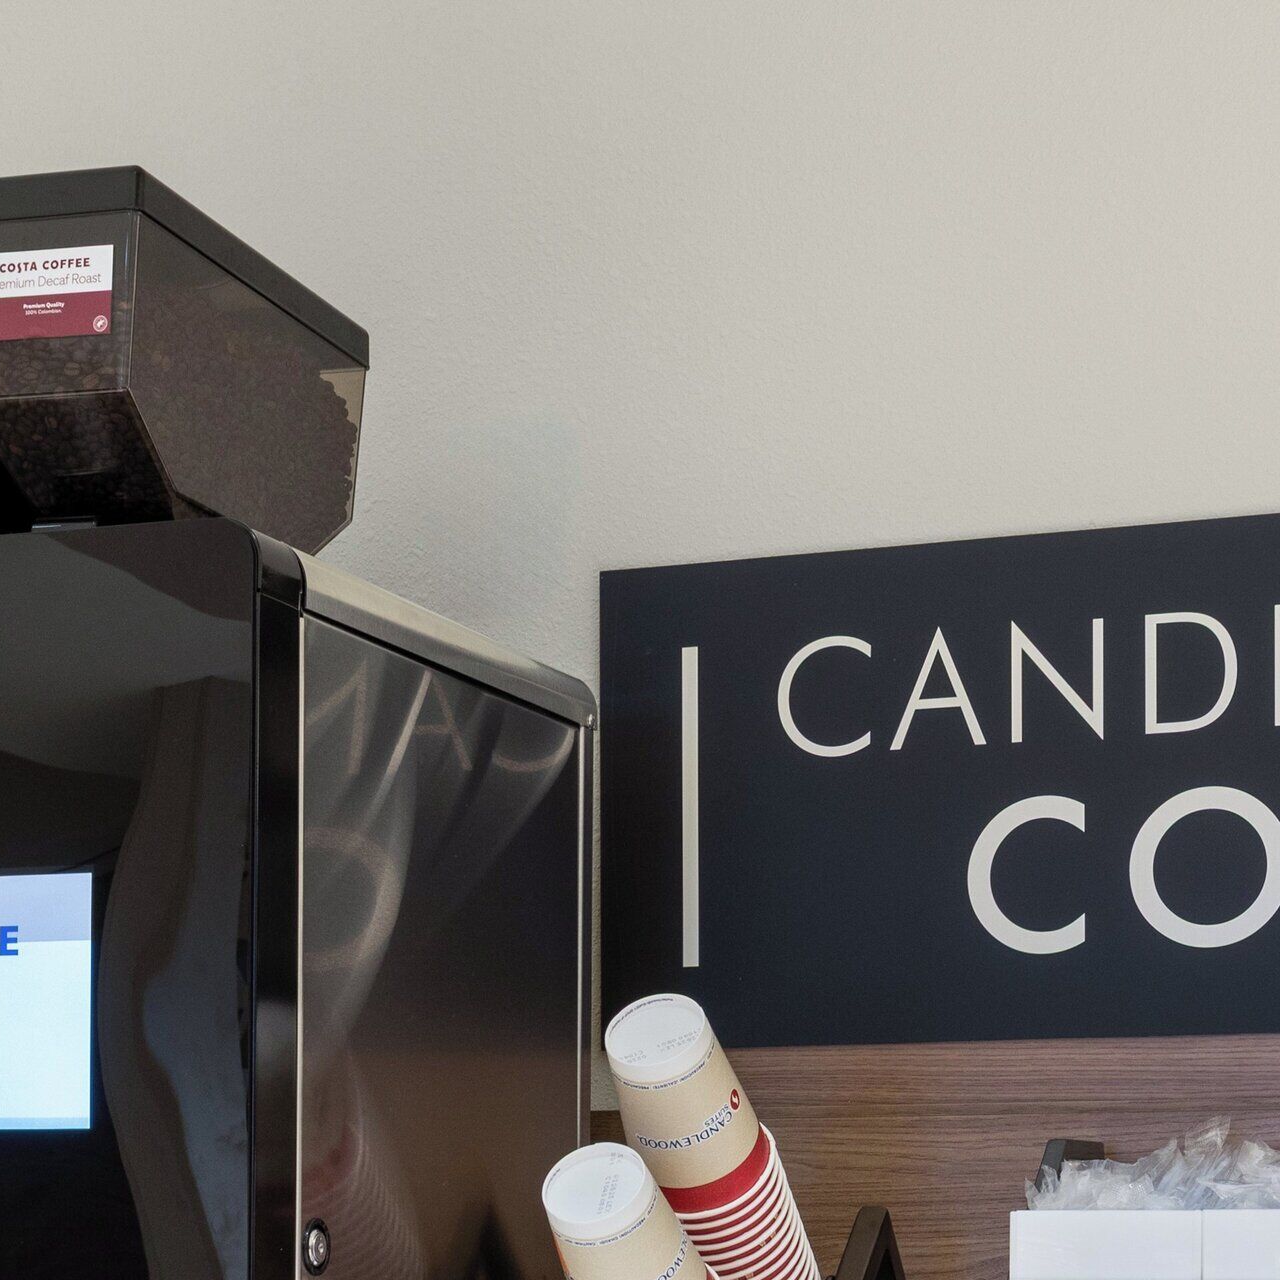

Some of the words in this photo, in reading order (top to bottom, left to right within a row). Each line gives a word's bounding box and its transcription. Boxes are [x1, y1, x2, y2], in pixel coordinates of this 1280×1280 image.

[0, 262, 37, 273] COSTA
[42, 257, 90, 270] COFFEE
[37, 274, 70, 287] Decaf
[72, 273, 101, 284] Roast
[704, 1103, 729, 1127] SUITES
[636, 1110, 734, 1151] CANDLEWOOD
